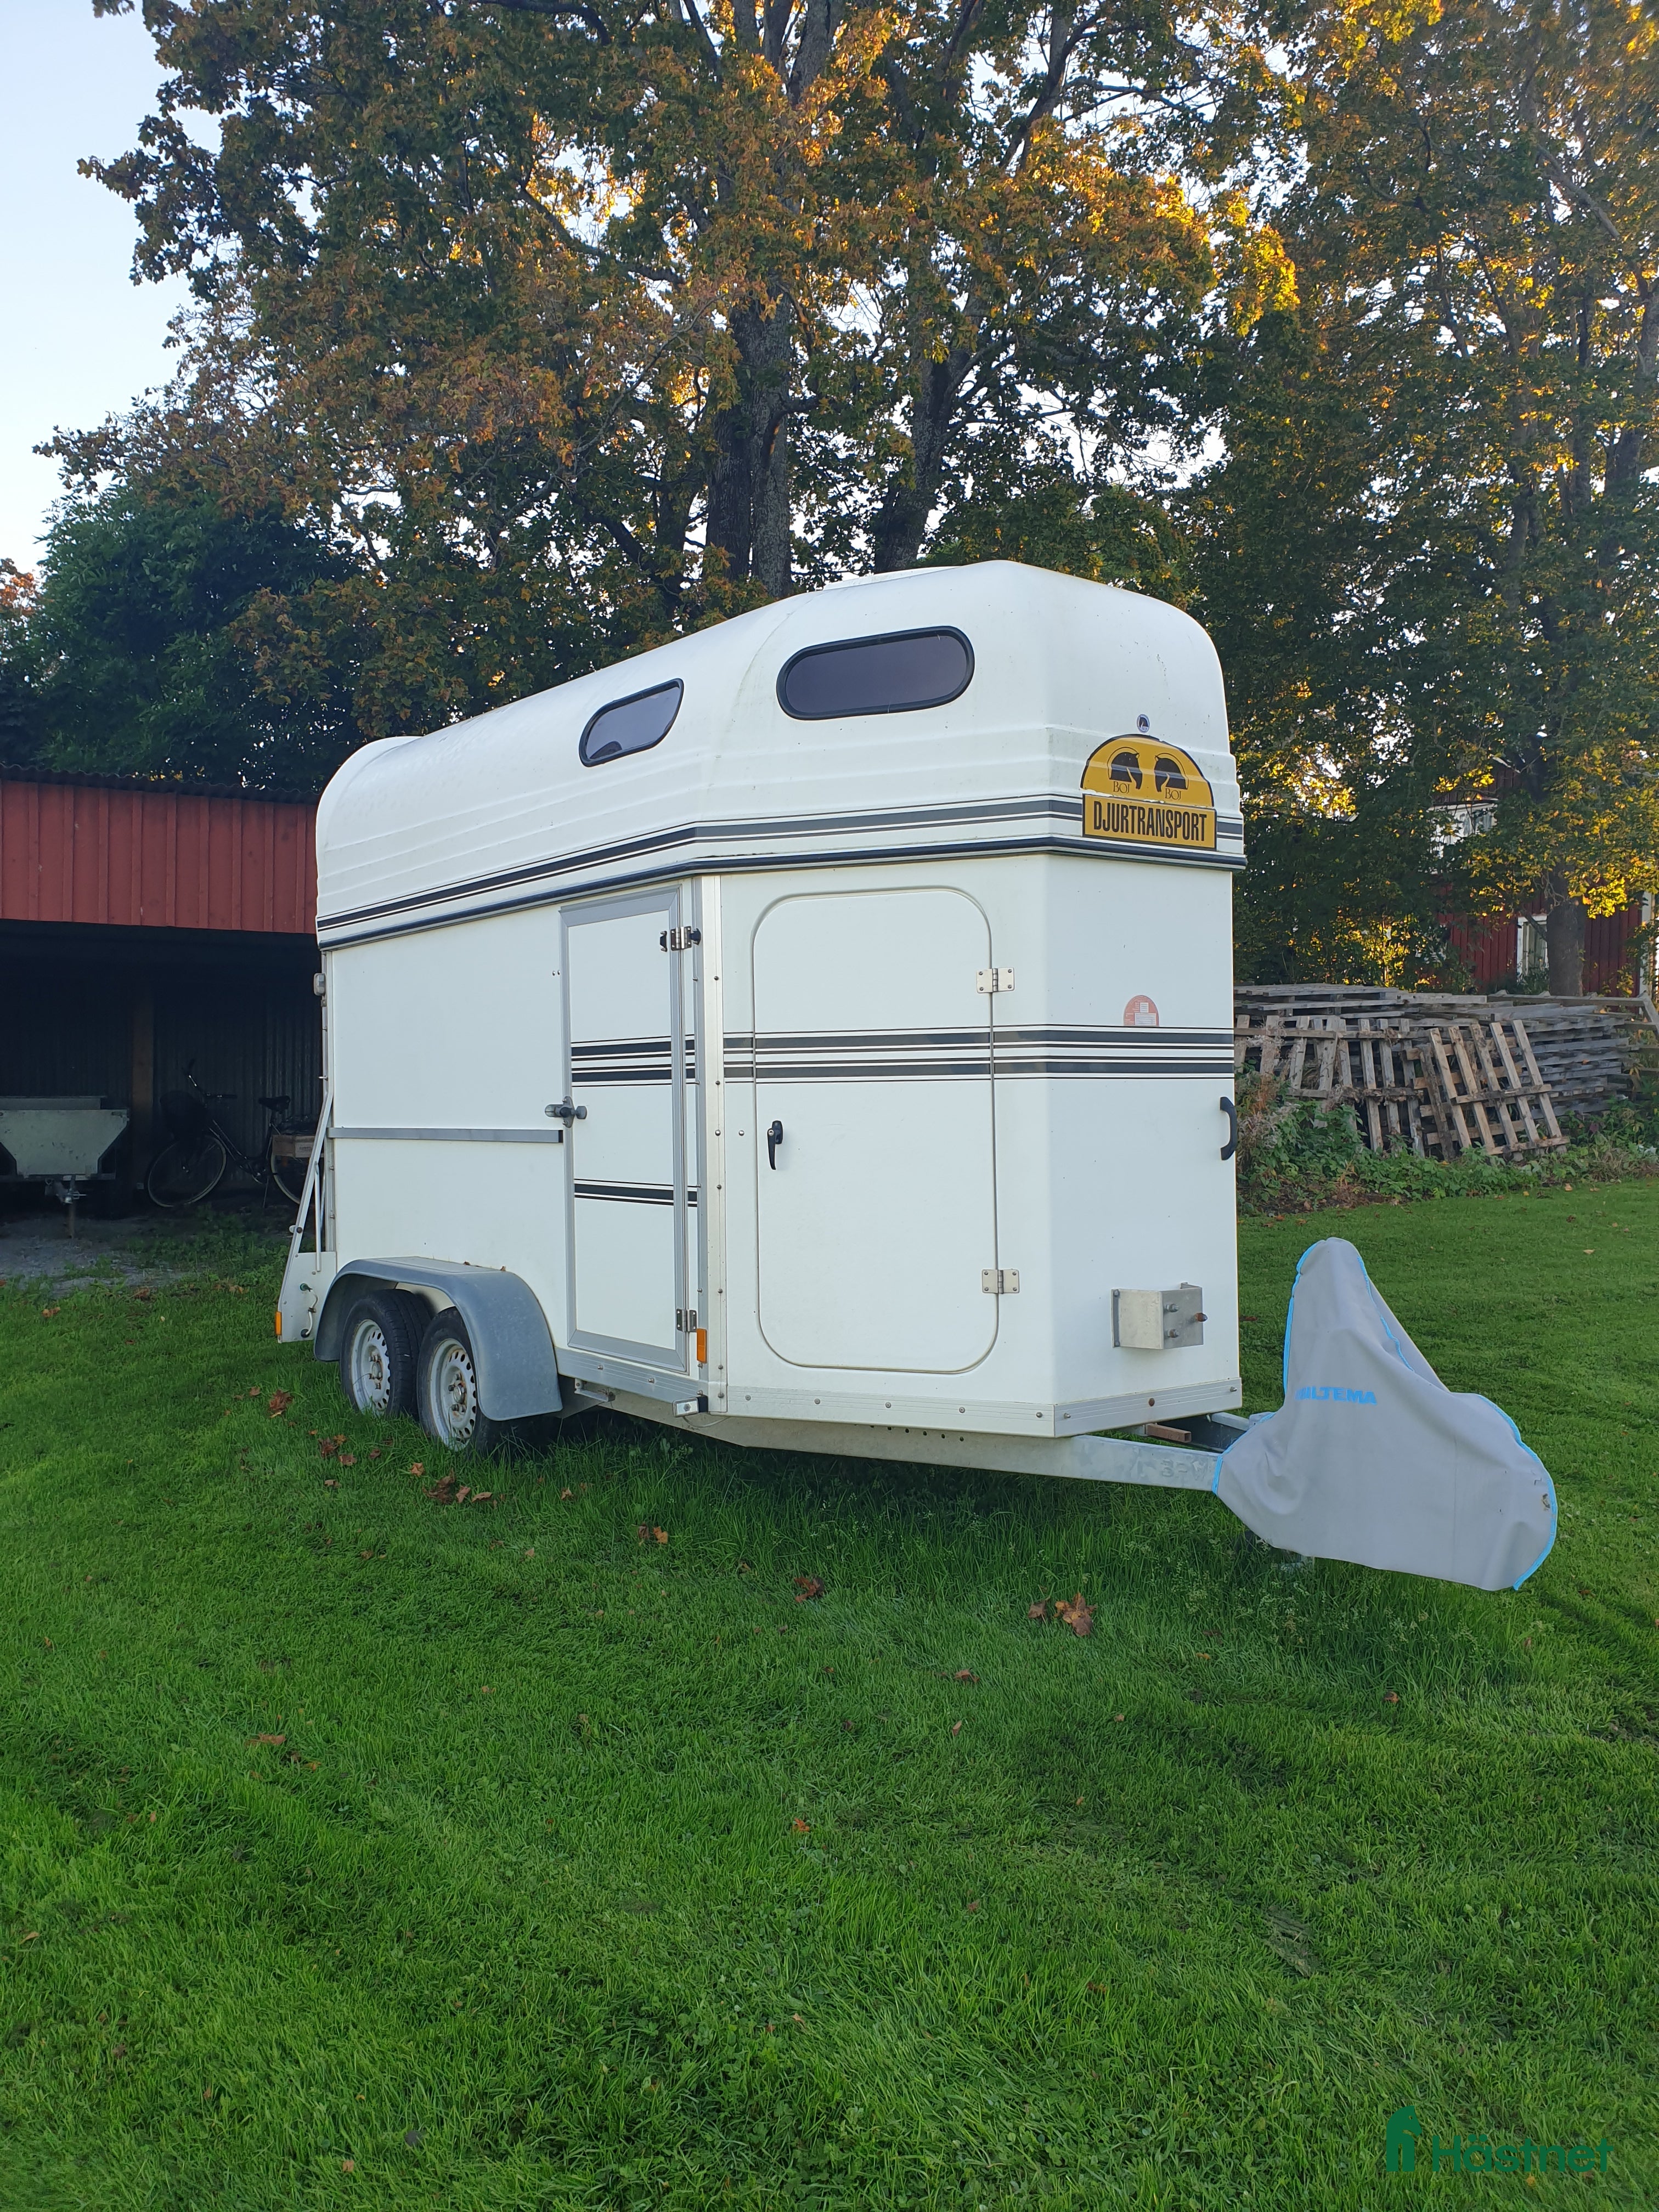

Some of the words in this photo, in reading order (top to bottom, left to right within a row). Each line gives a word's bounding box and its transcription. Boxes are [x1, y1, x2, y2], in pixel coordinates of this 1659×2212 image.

[1113, 781, 1130, 794] BOJ
[1165, 788, 1181, 800] BOJ
[1093, 801, 1207, 841] DJURTRANSPORT
